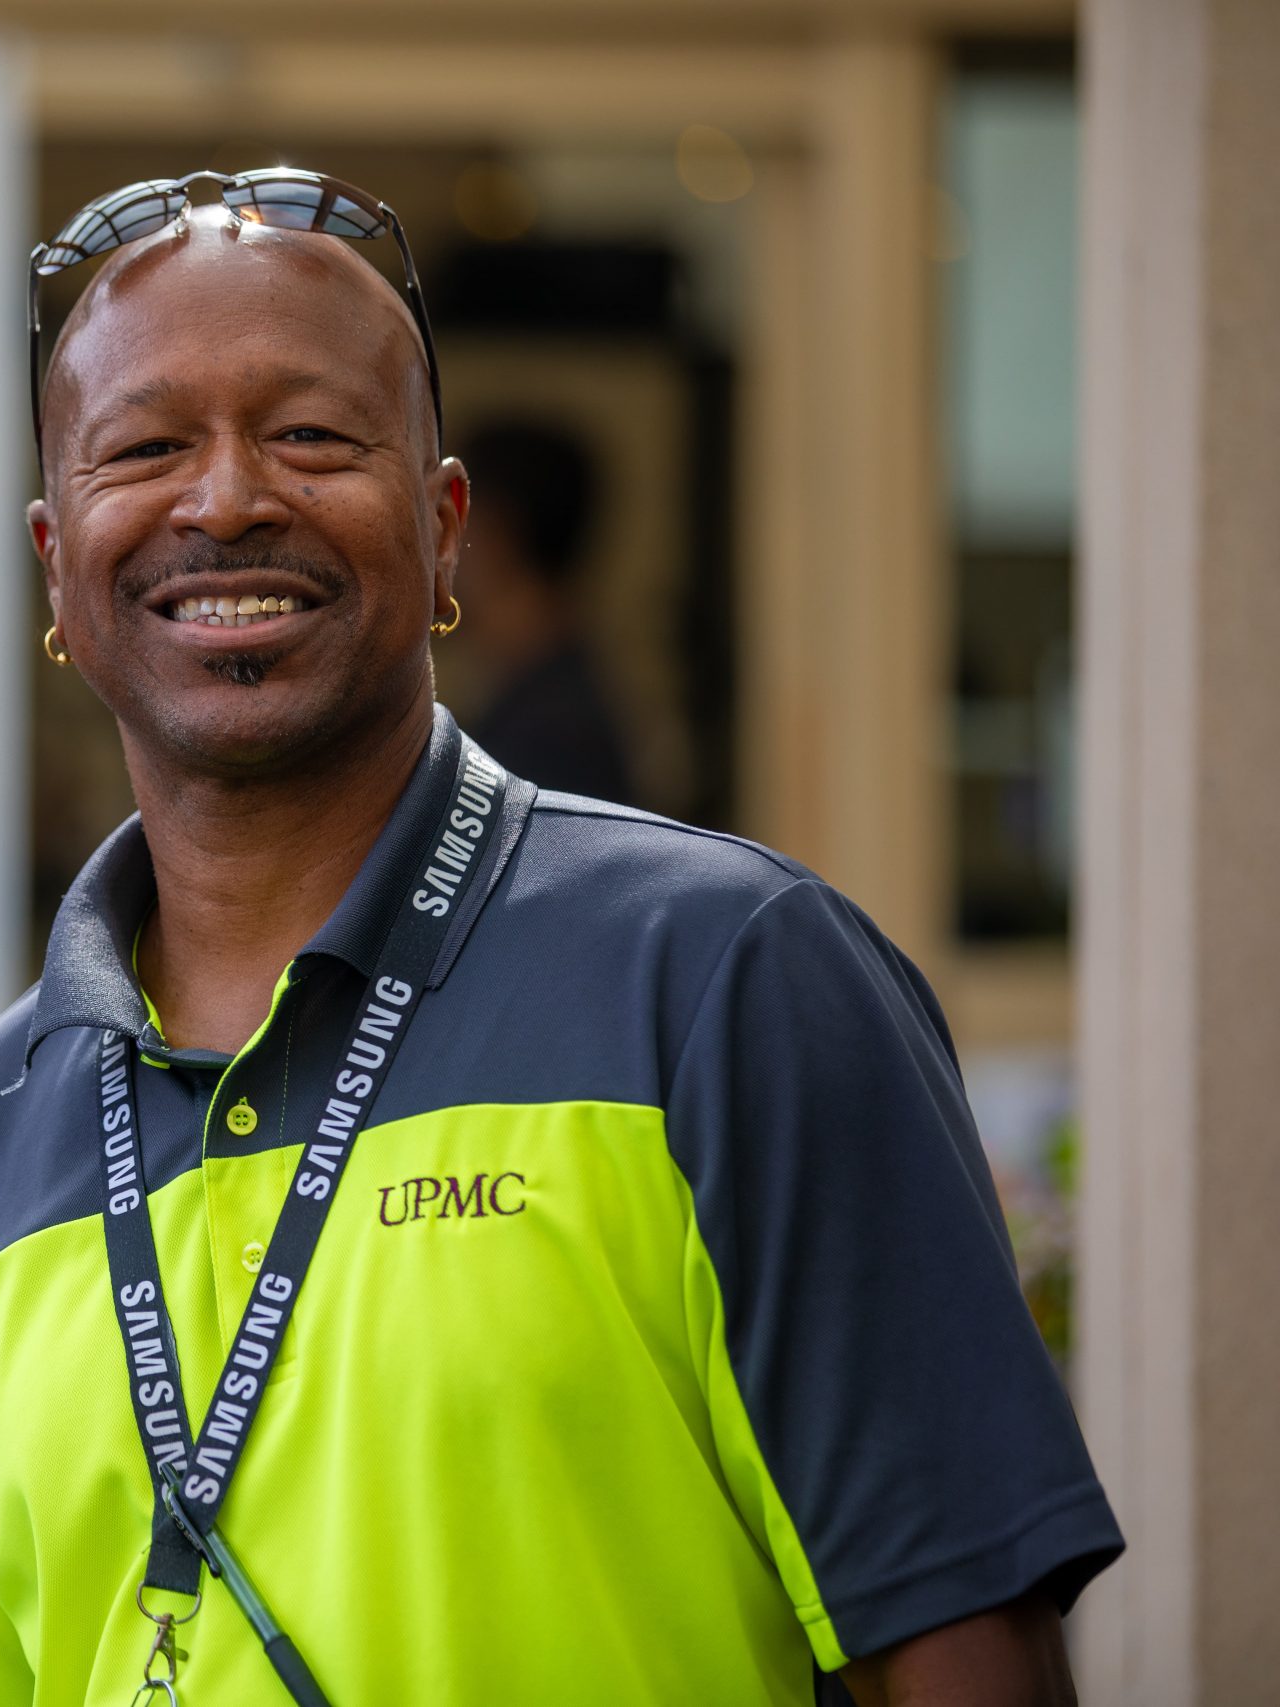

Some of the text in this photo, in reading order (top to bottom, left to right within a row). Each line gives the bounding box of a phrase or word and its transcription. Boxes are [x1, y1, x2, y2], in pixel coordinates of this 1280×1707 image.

[412, 751, 501, 917] SAMSUNG
[297, 975, 413, 1201] SAMSUNG
[377, 1171, 527, 1227] UPMC
[120, 1279, 188, 1501] SAMSUN
[184, 1272, 293, 1505] SAMSUNG
